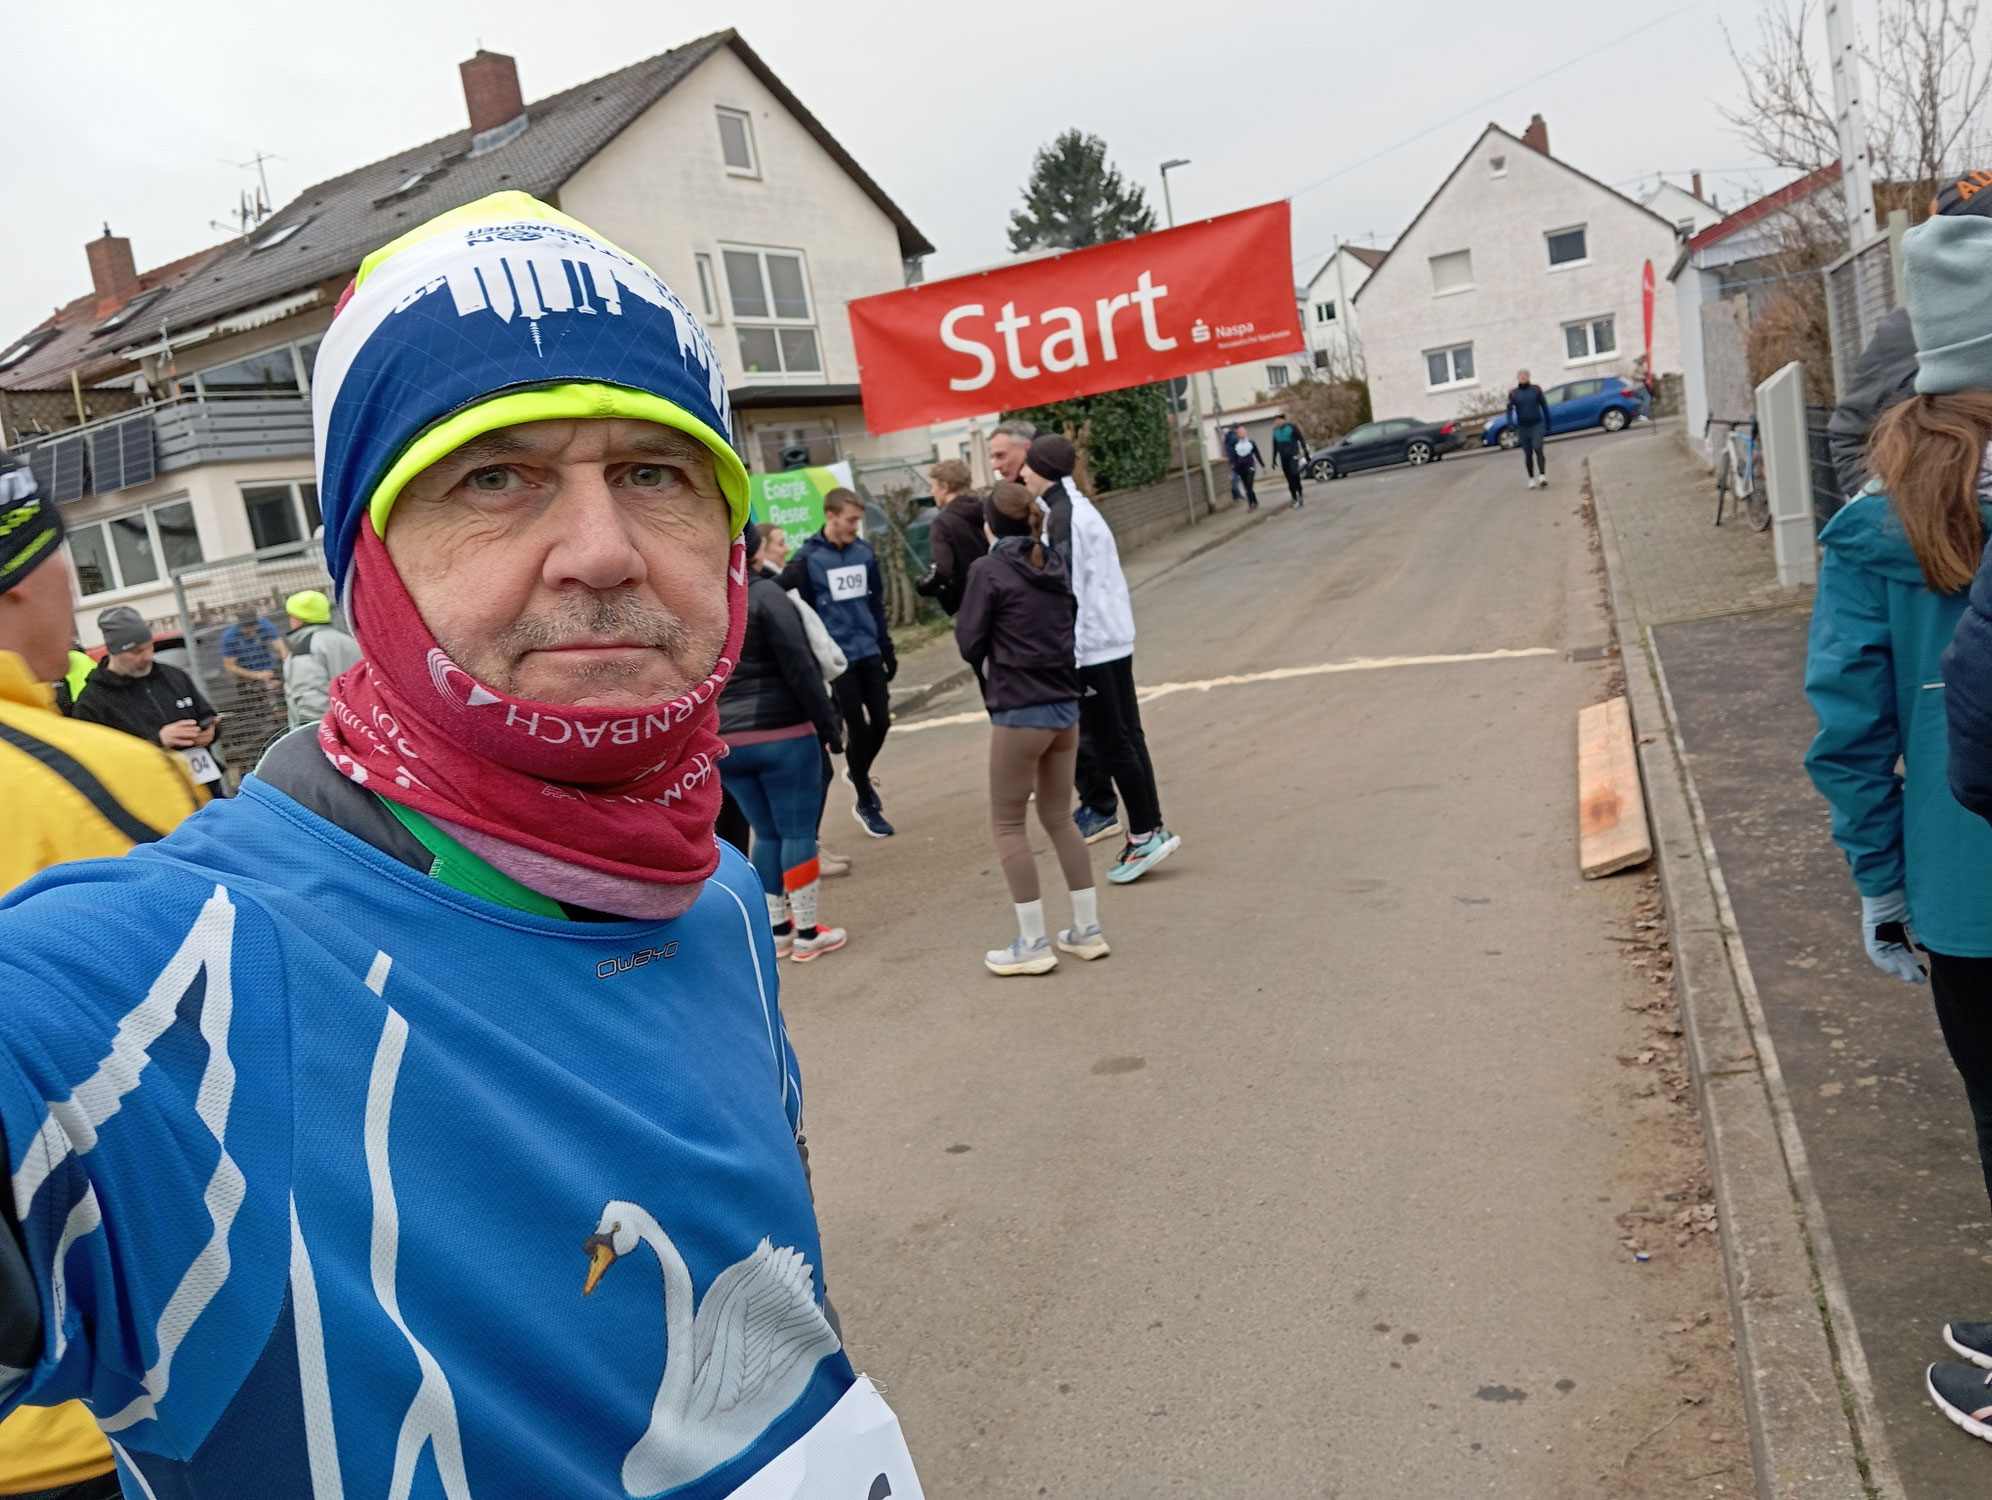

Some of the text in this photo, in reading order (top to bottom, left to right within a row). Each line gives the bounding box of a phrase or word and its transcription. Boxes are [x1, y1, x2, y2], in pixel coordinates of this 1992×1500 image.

[939, 270, 1178, 392] Start
[1215, 322, 1255, 338] Naspa
[836, 573, 863, 591] 209
